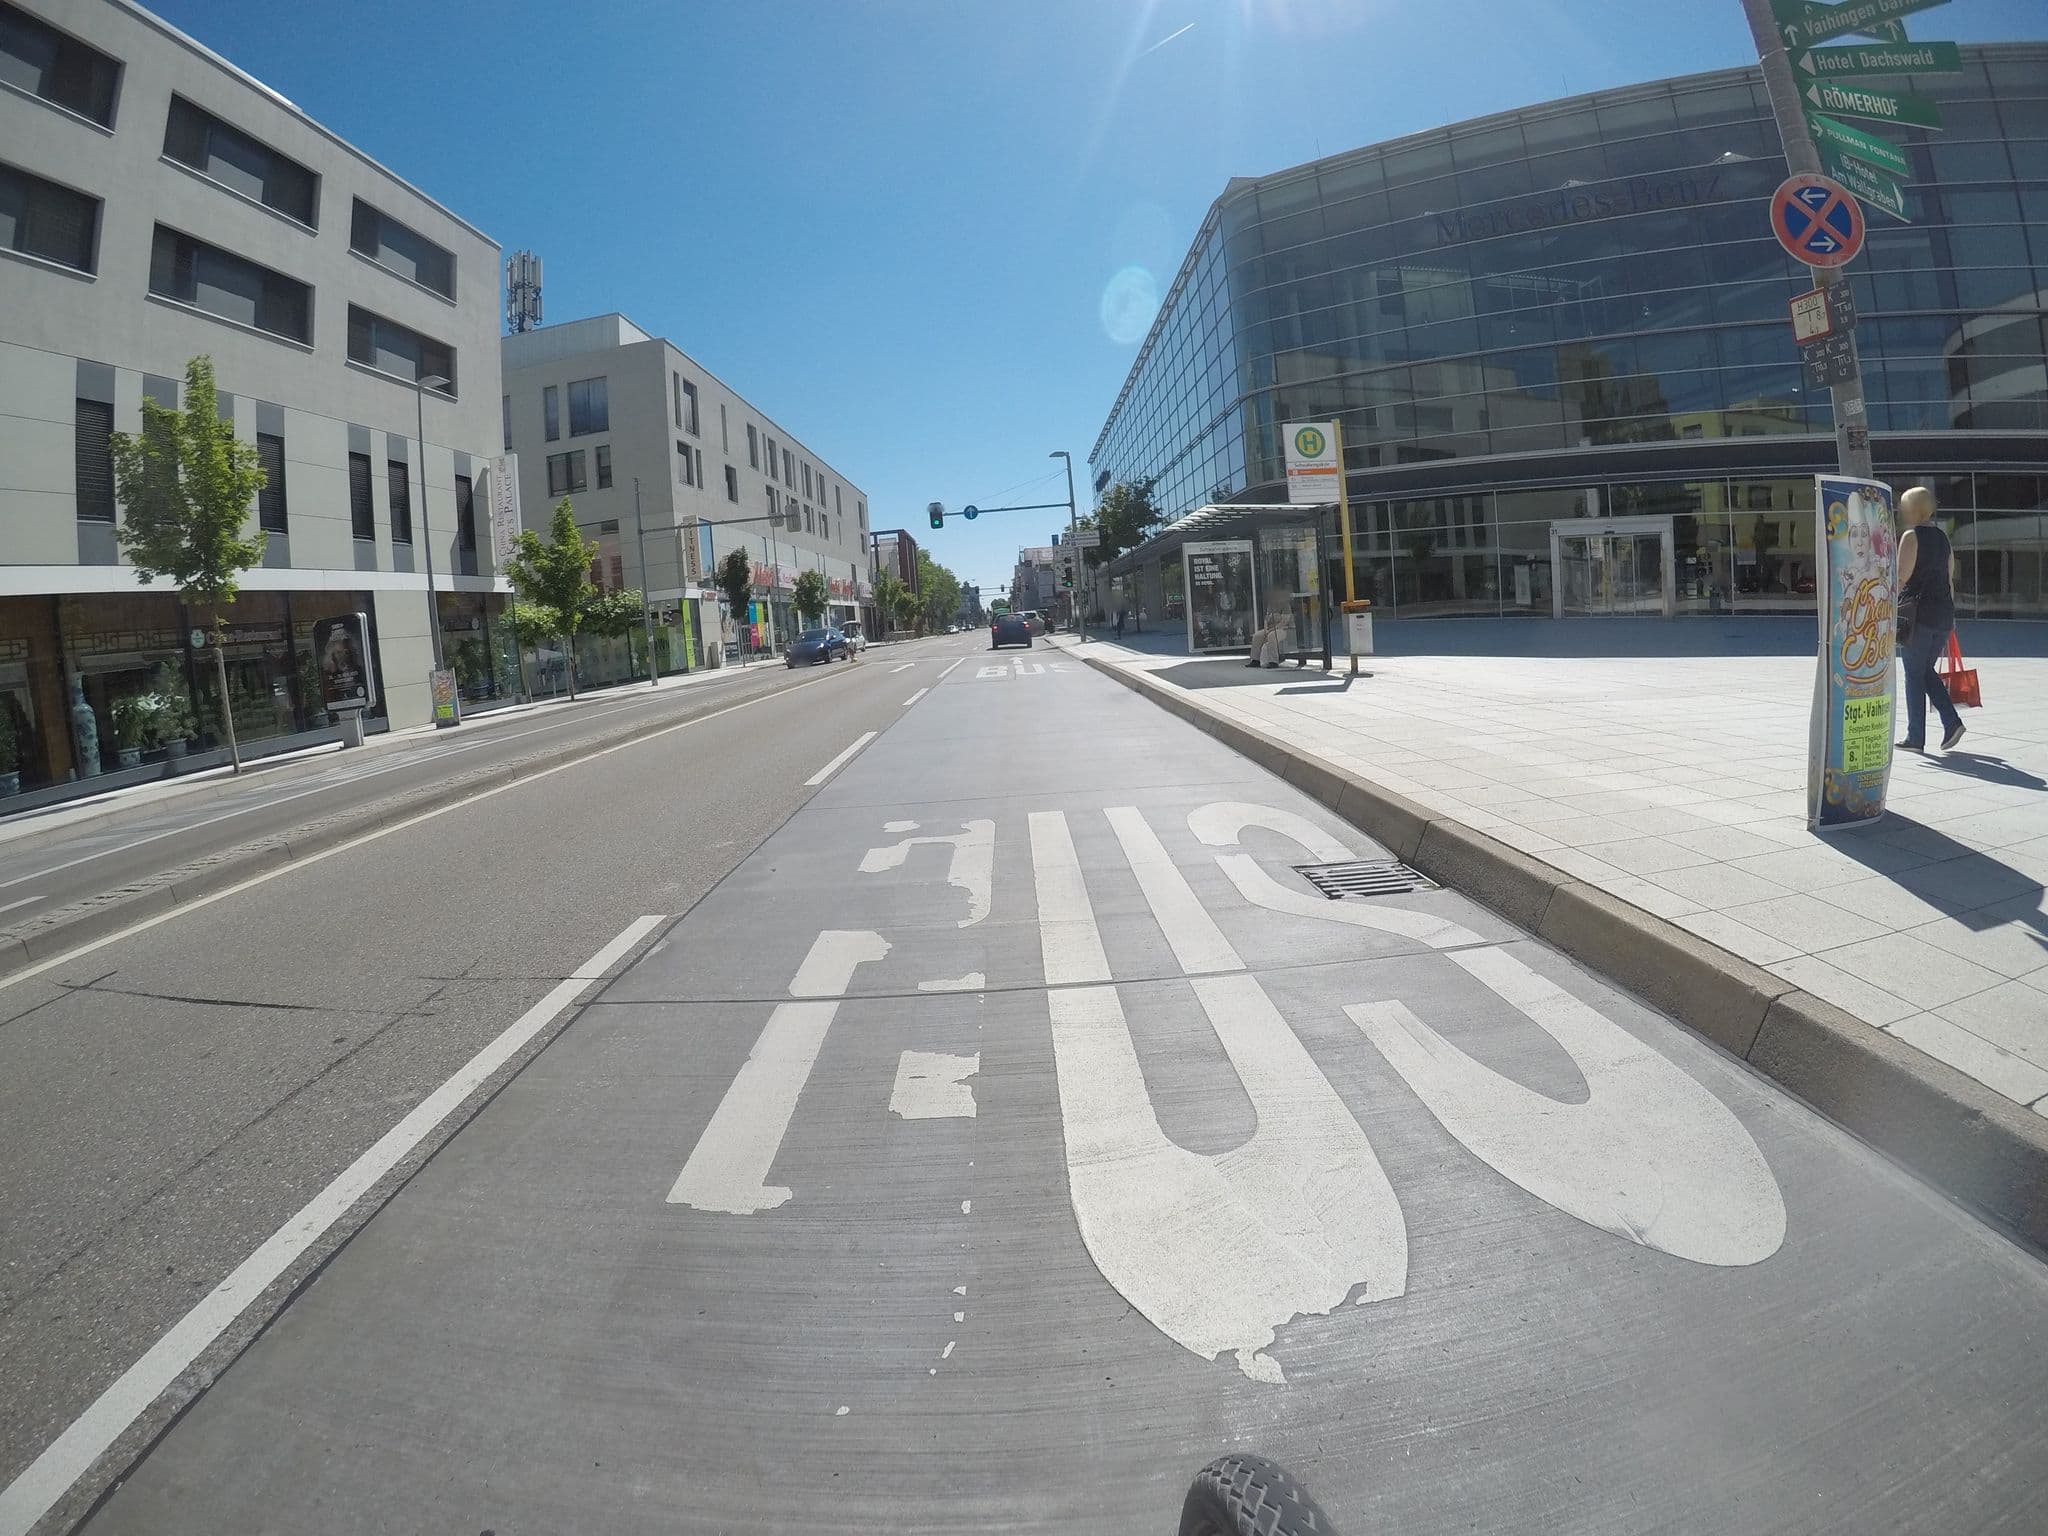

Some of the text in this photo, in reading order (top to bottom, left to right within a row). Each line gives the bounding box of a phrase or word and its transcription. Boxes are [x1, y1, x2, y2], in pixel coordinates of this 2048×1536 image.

[1803, 7, 1876, 36] Vaihingen
[1817, 49, 1935, 71] Hotel Dachswald
[1823, 88, 1898, 117] RÖMERHOF
[1826, 128, 1867, 151] PULLMAN
[504, 473, 514, 514] PALACE
[688, 521, 697, 576] ITNESS
[1849, 751, 1858, 762] 8.
